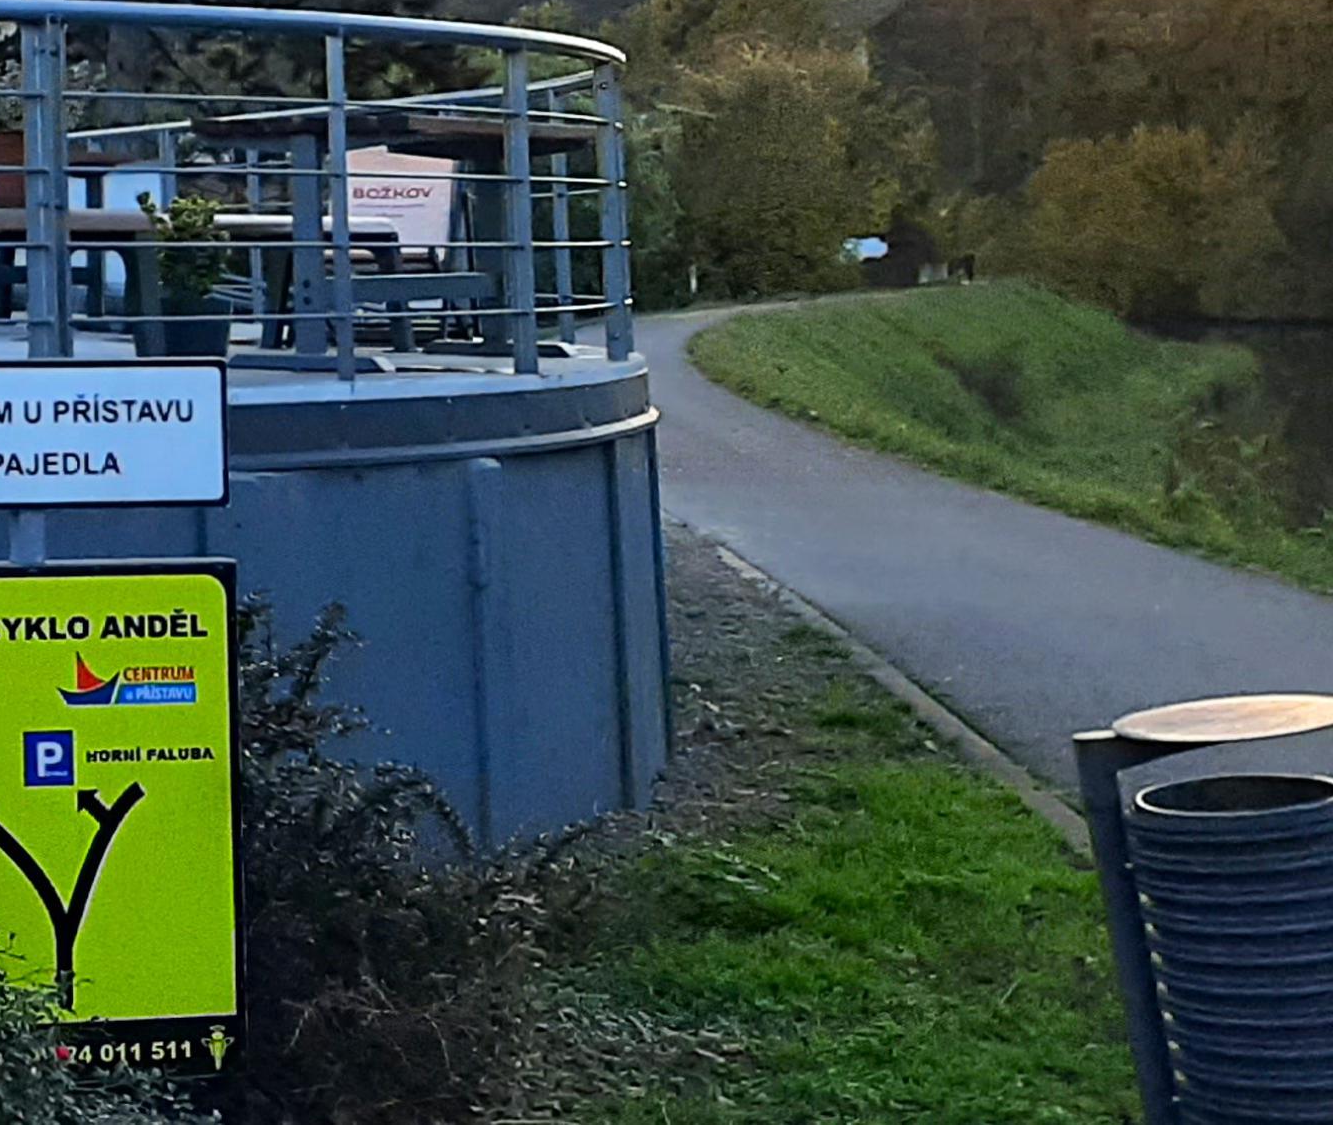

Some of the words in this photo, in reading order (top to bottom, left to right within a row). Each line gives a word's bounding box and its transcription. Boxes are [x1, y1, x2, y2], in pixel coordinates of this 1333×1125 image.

[23, 400, 42, 423] U
[53, 394, 194, 423] PŘÍSTAVU
[100, 608, 208, 639] ANDĚL
[123, 666, 195, 682] CENTRUM
[36, 741, 64, 778] P
[86, 747, 141, 763] HORNÍ
[100, 1043, 142, 1063] 011
[151, 1040, 192, 1060] 511
